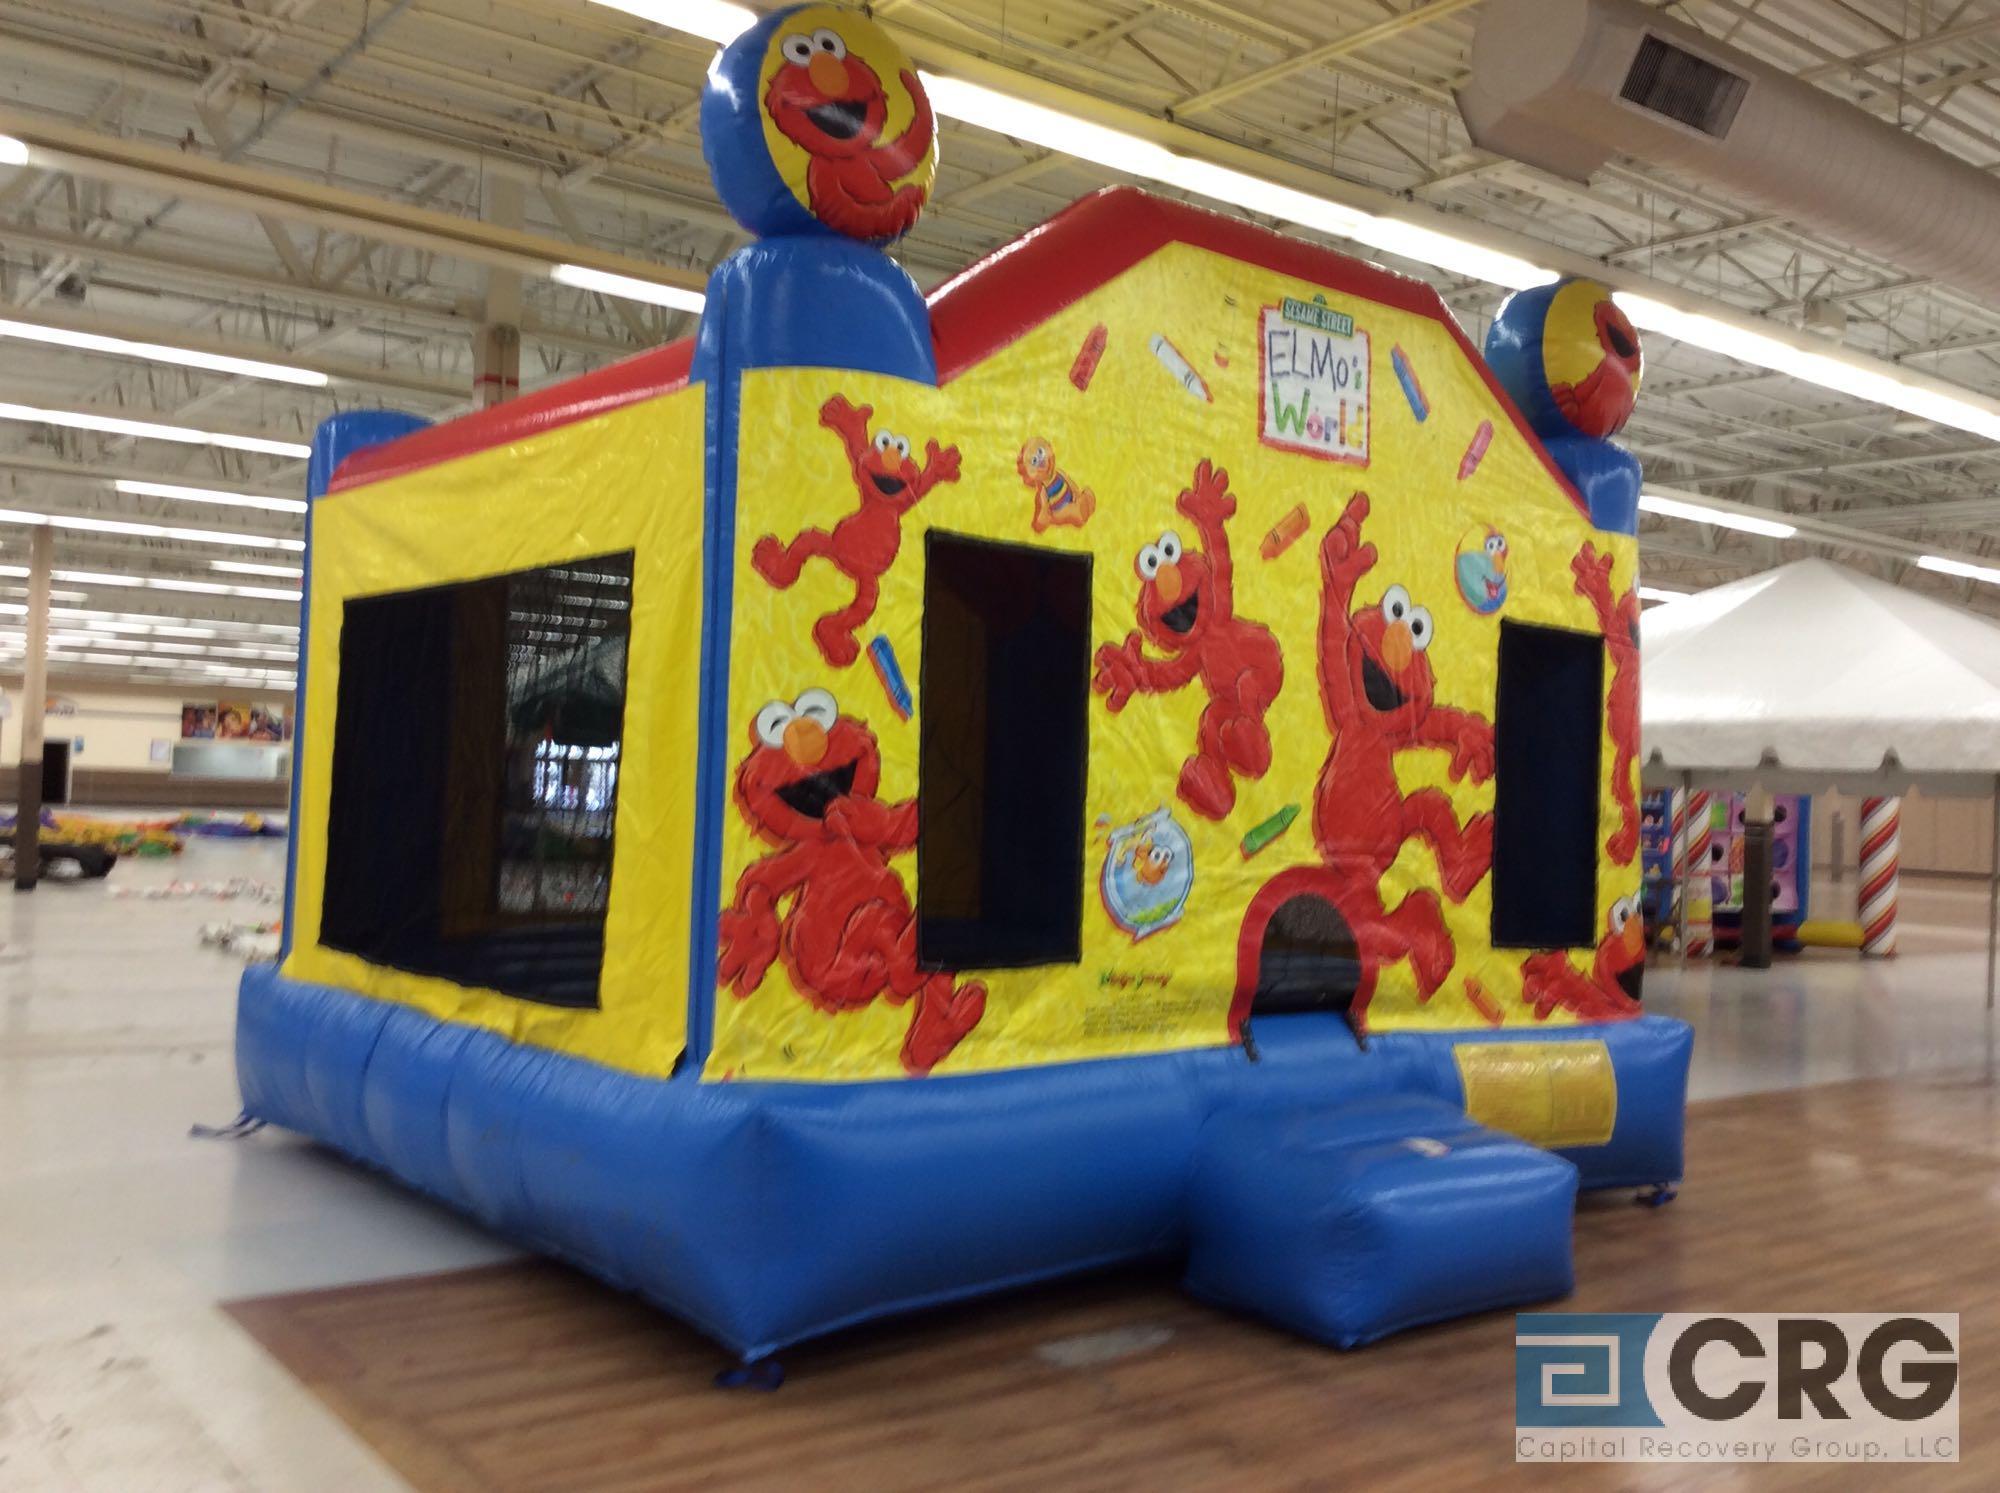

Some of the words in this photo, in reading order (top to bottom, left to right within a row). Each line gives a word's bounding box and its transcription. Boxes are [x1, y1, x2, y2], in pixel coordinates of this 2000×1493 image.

[1285, 299, 1318, 326] SESAME
[1321, 310, 1353, 337] STREET
[1271, 381, 1364, 449] World
